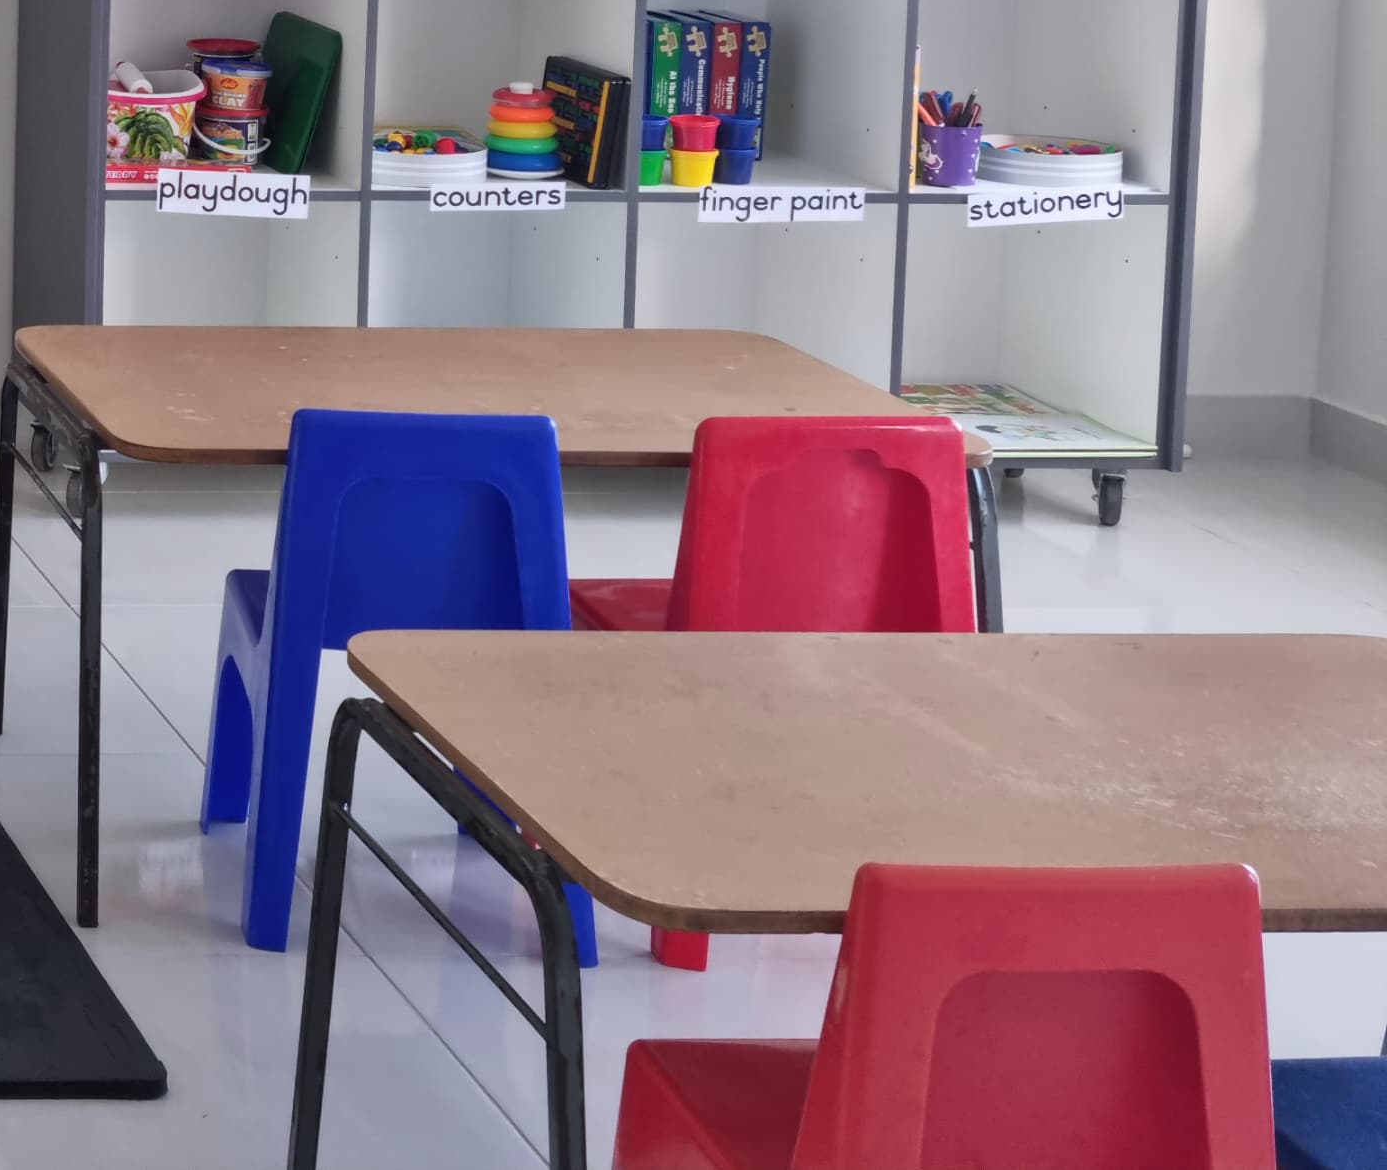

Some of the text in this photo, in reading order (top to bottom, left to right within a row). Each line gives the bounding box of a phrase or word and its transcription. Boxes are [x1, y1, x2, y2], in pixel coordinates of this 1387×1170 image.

[670, 70, 677, 80] At
[757, 58, 765, 82] People
[669, 82, 677, 96] the
[725, 76, 735, 110] Hygiene
[756, 83, 764, 98] Who
[212, 95, 246, 107] CLAY
[754, 100, 763, 115] Help
[159, 171, 308, 216] playdough
[433, 187, 561, 207] counters
[700, 186, 863, 222] finger paint
[969, 190, 1123, 221] stationery
